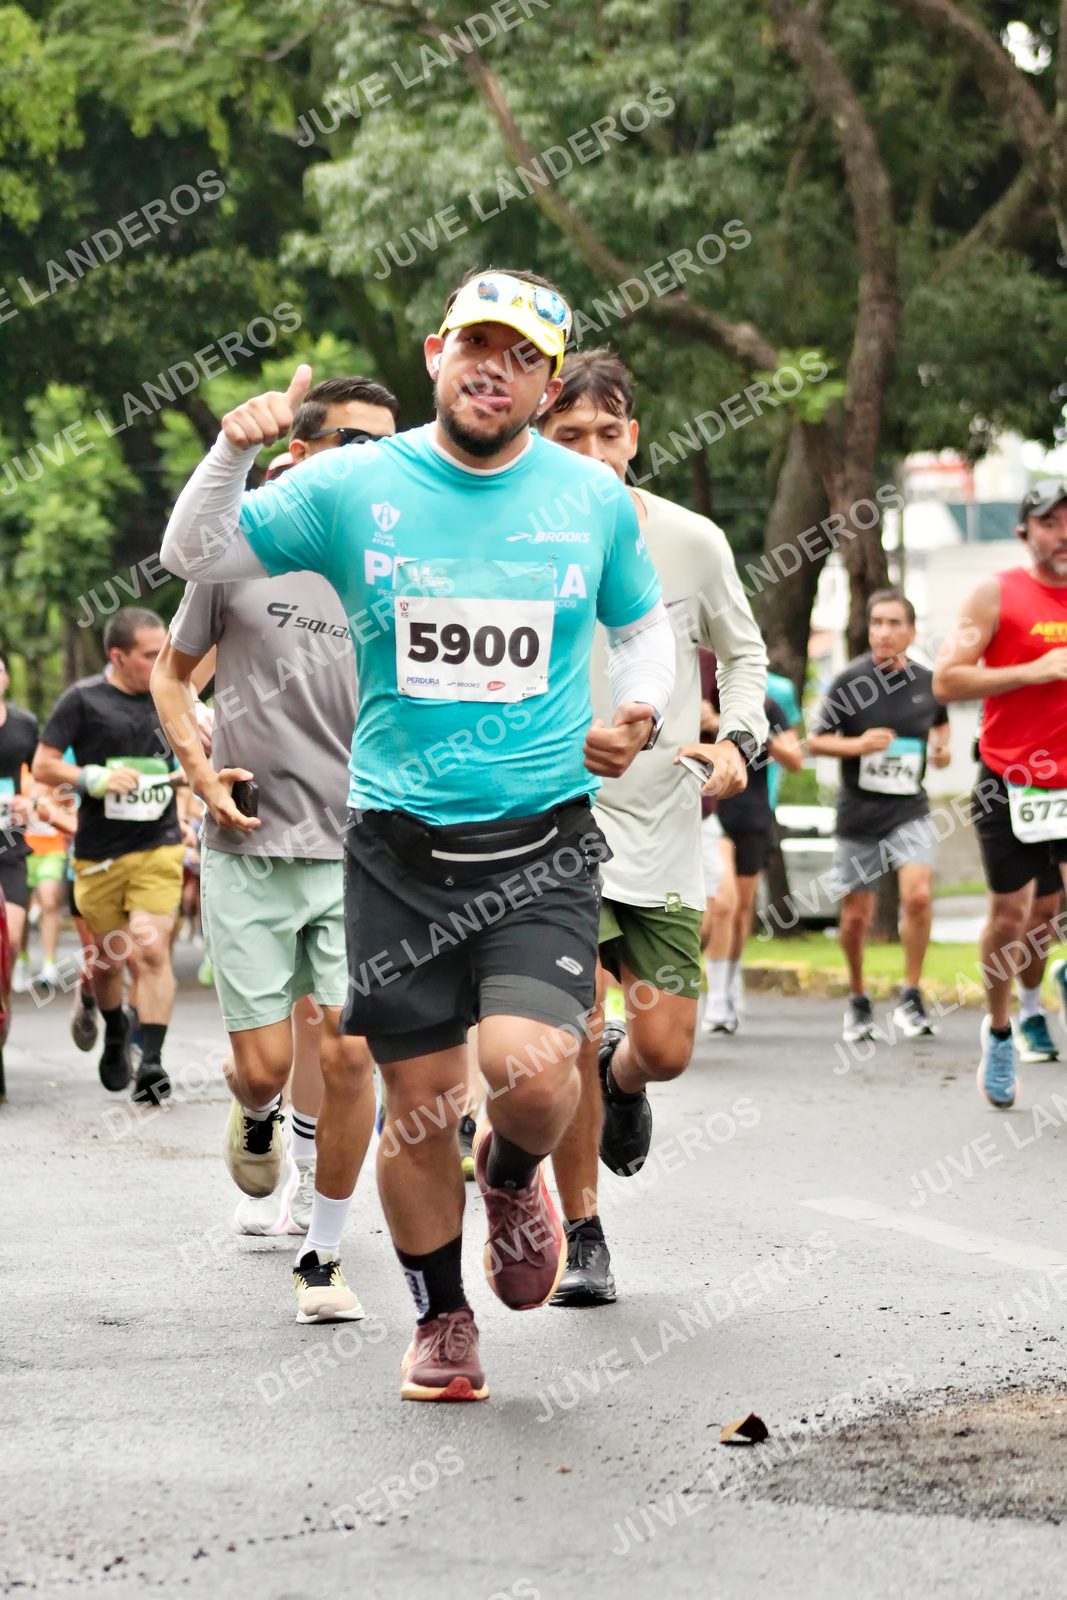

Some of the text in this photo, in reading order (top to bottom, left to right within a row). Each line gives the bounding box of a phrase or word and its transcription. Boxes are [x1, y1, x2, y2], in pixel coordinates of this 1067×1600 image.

[534, 531, 591, 543] BROOKS
[407, 622, 540, 668] 5900
[406, 676, 440, 686] PERDURA
[456, 681, 480, 689] BROOKS
